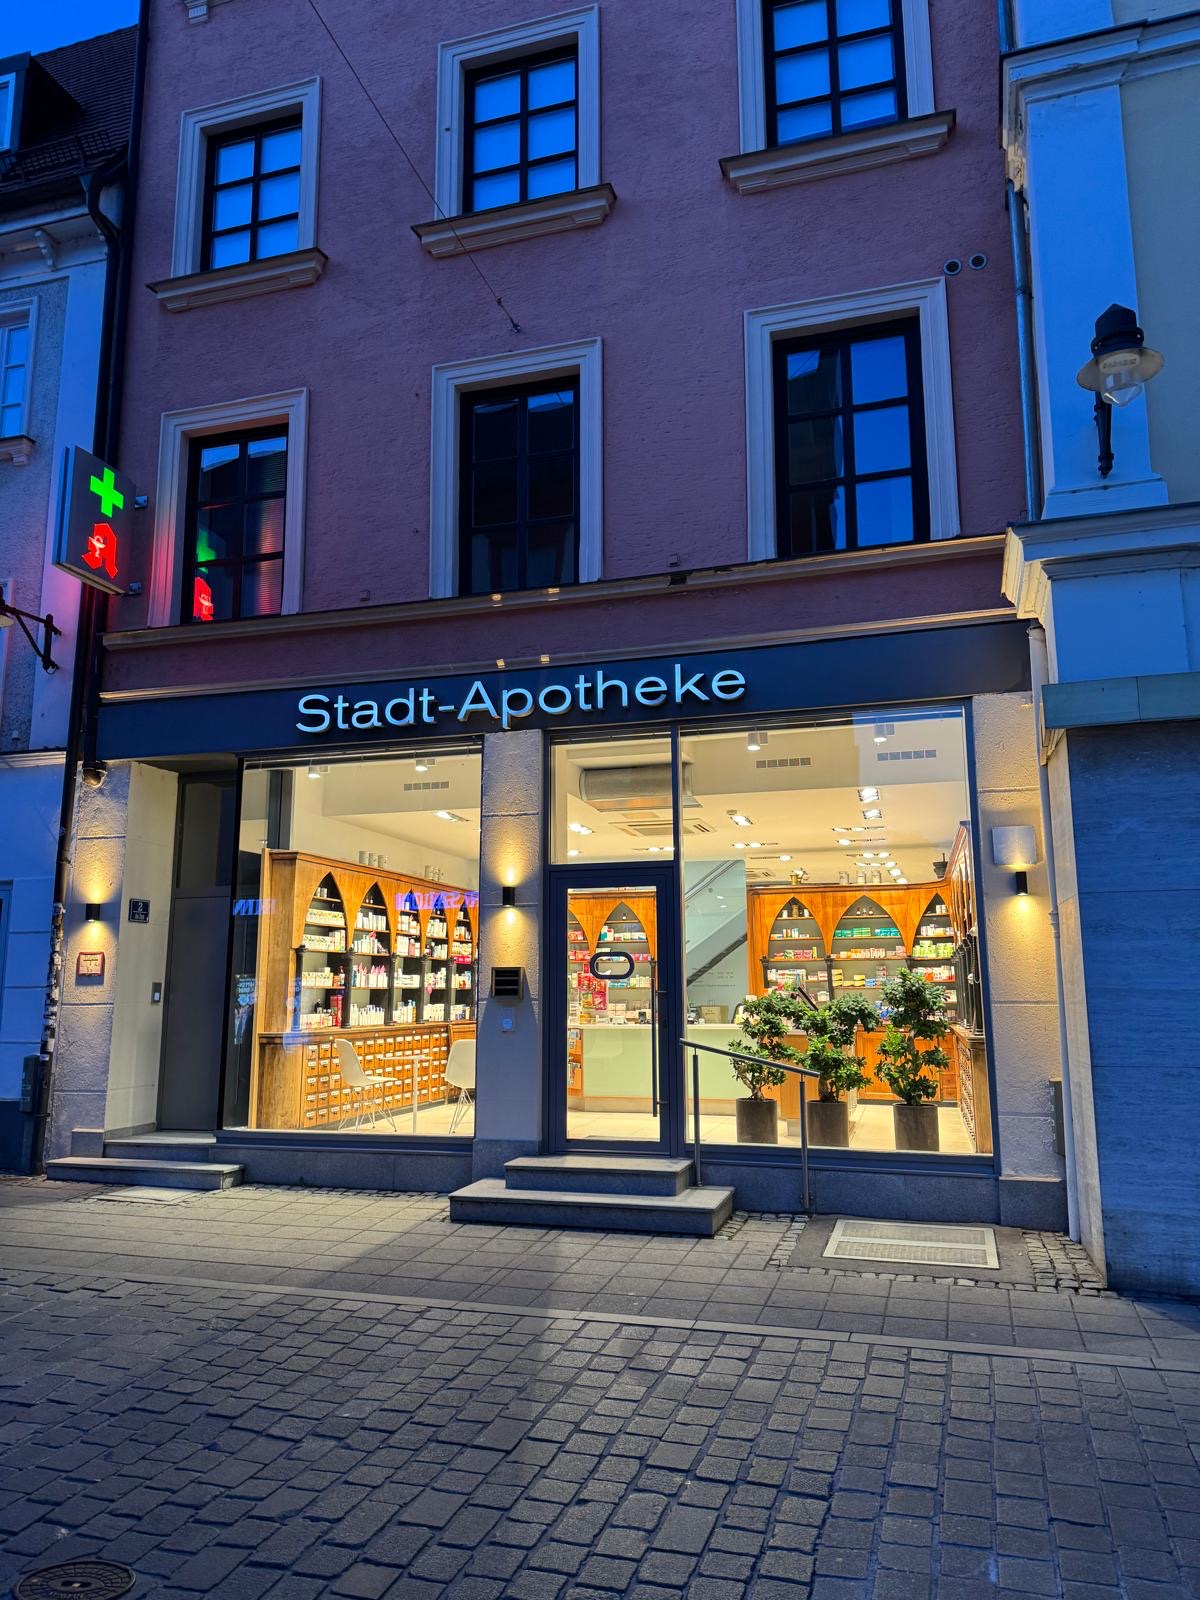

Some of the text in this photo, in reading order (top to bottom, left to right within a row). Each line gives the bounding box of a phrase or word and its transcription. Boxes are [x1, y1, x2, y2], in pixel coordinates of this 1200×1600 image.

[81, 523, 118, 579] A
[296, 663, 747, 735] Stadt-Apotheke
[137, 902, 144, 912] 2
